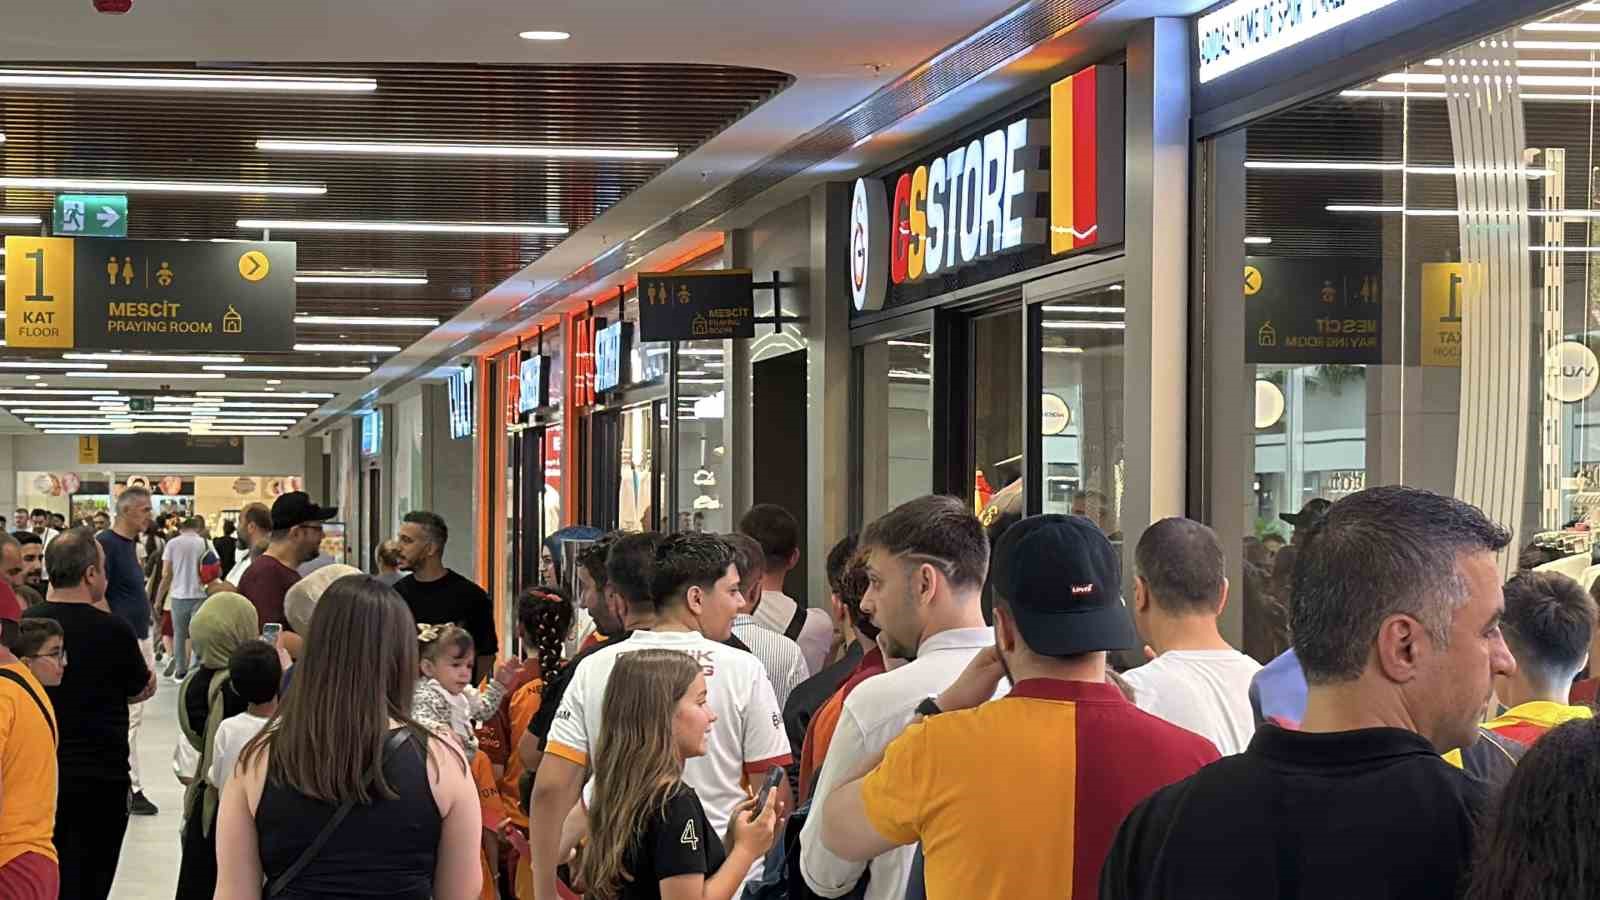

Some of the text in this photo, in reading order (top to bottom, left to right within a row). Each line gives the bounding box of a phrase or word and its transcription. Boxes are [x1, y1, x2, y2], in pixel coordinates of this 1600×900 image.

[25, 248, 54, 302] 1
[108, 299, 181, 318] MESCİT
[23, 311, 55, 325] KAT
[18, 326, 60, 338] FLOOR
[107, 320, 214, 334] PRAYING ROOM
[680, 818, 699, 851] 4
